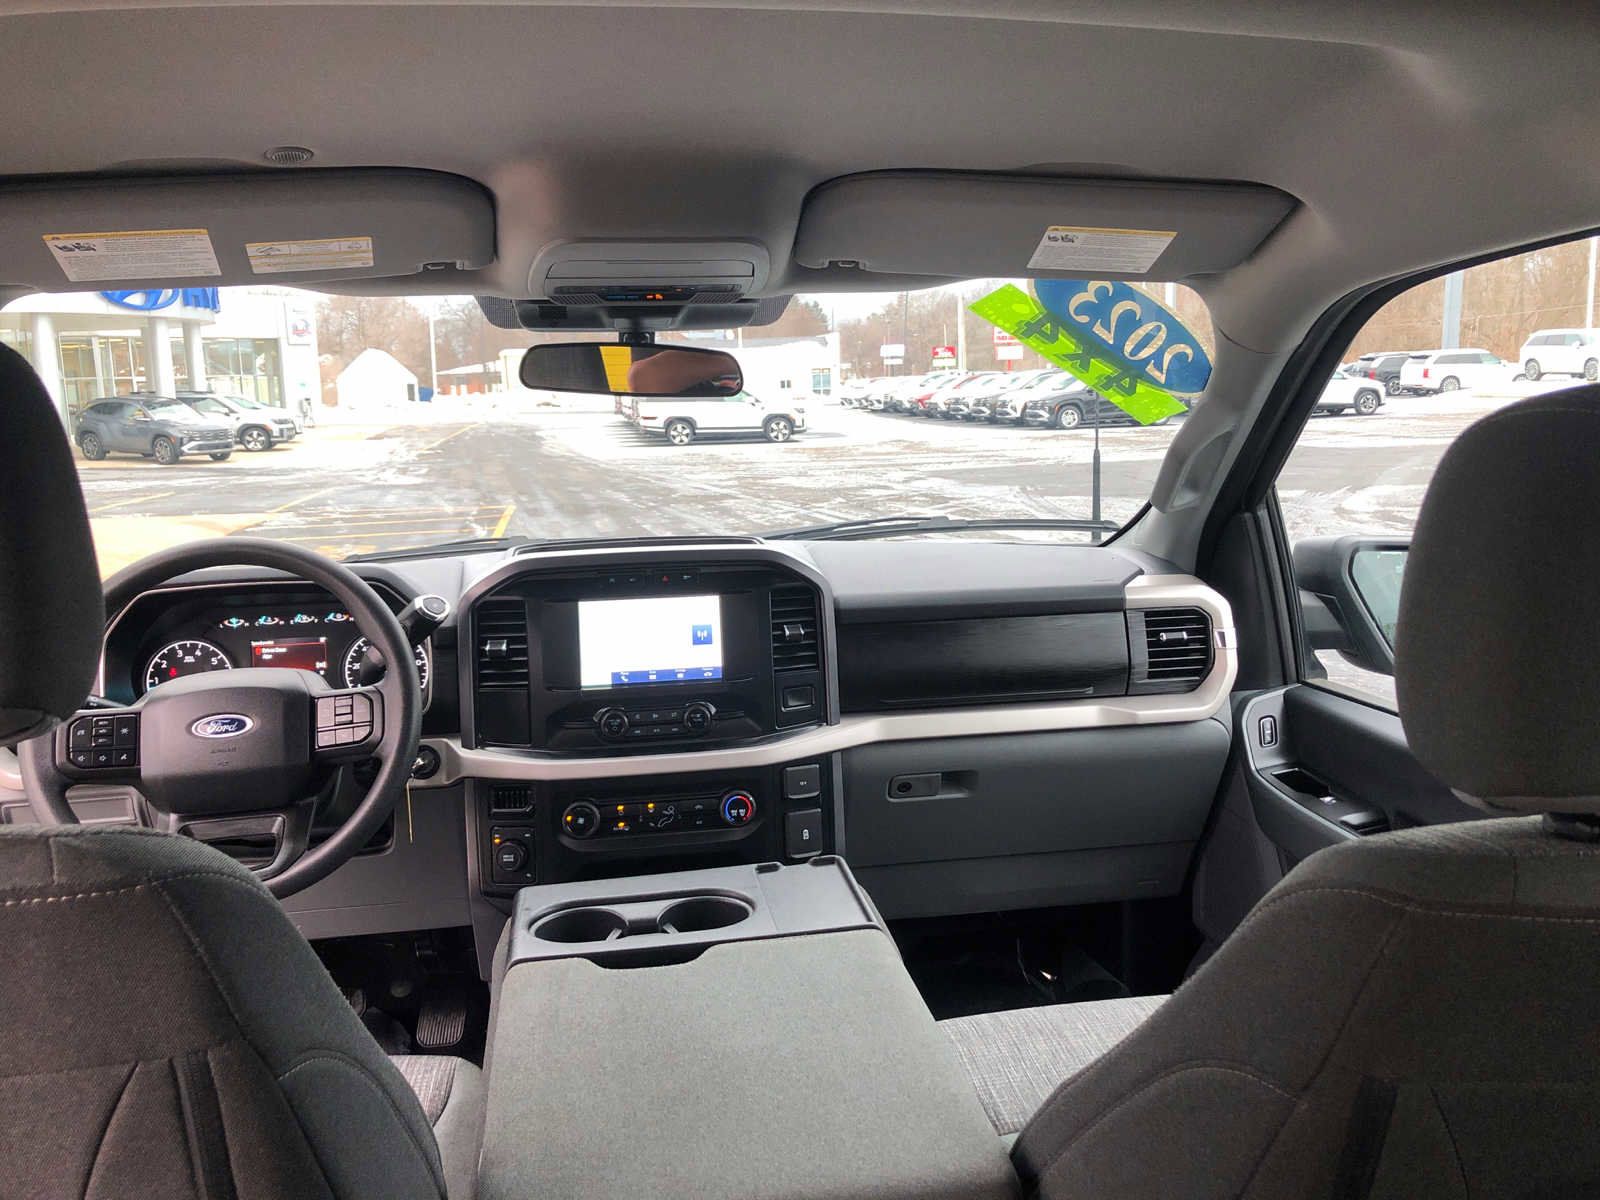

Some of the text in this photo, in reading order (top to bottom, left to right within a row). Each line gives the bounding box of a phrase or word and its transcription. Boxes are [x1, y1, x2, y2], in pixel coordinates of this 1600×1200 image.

[177, 650, 183, 658] 3
[160, 660, 167, 668] 2
[211, 657, 218, 665] 5
[207, 719, 238, 733] Ford
